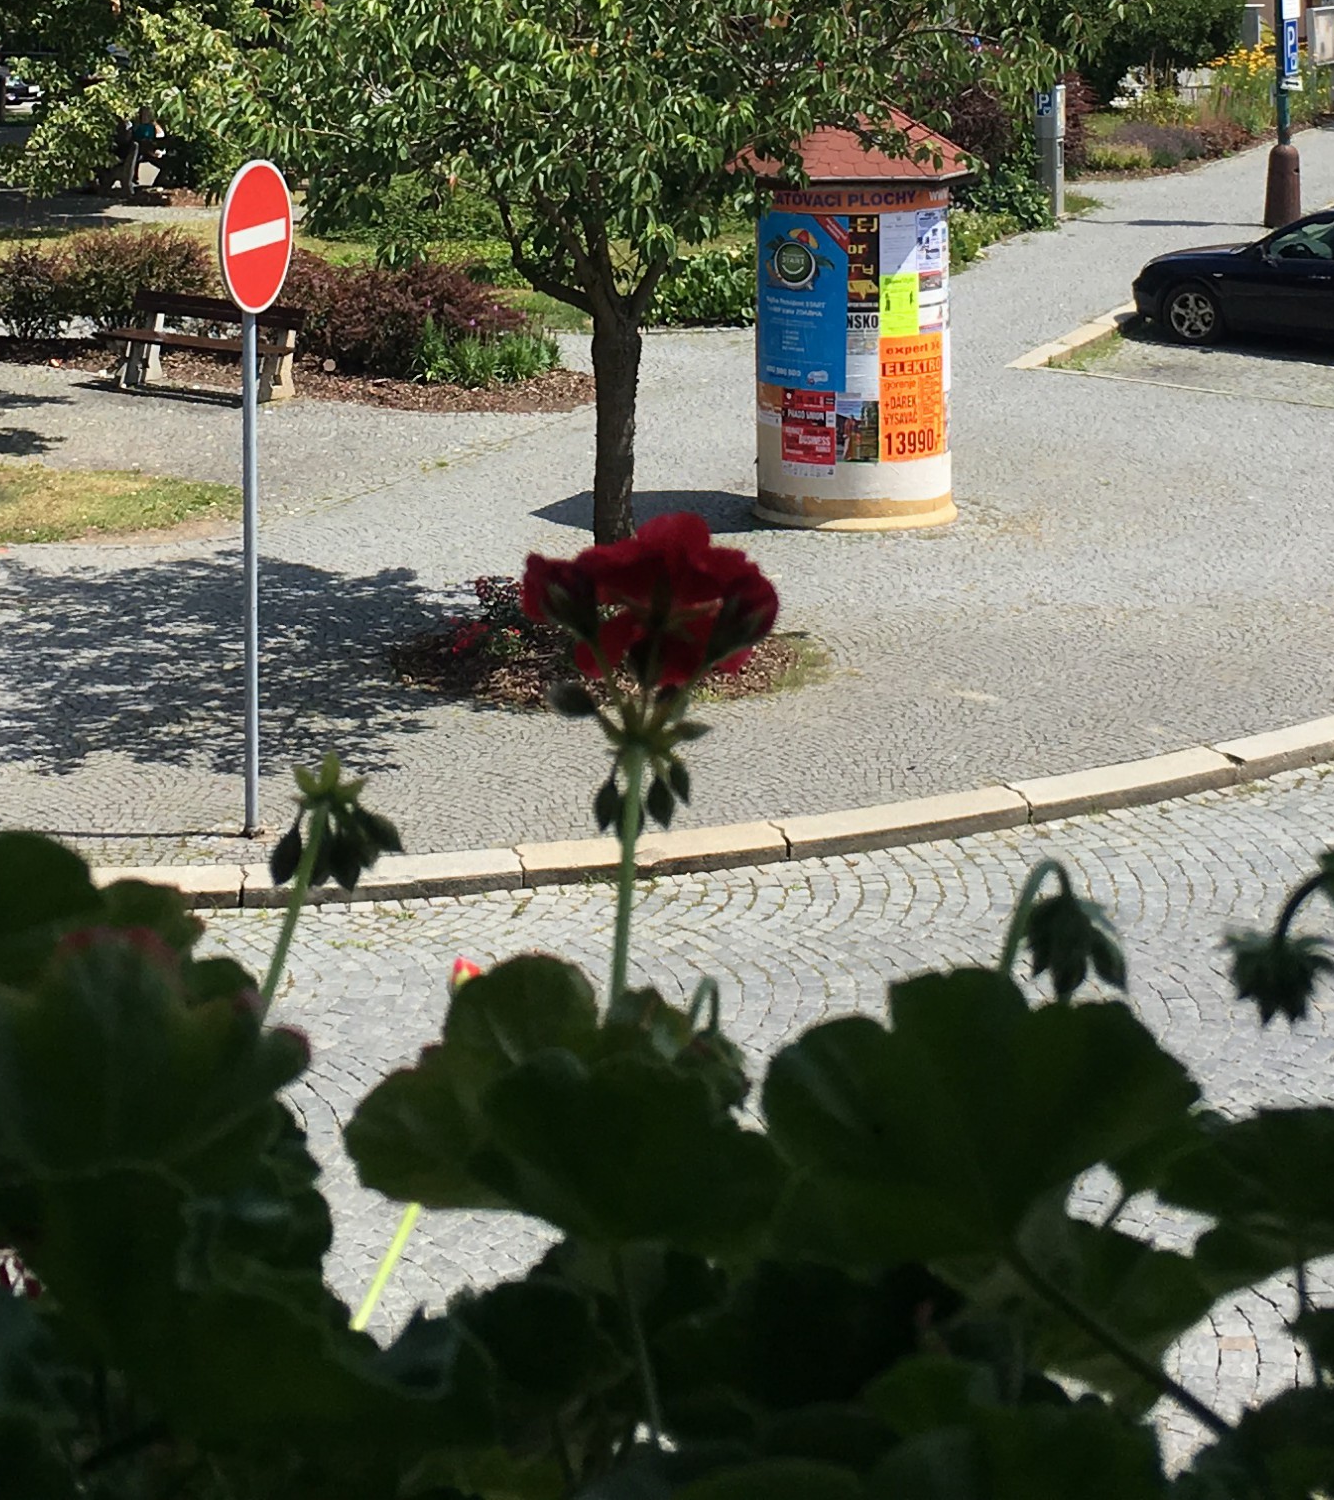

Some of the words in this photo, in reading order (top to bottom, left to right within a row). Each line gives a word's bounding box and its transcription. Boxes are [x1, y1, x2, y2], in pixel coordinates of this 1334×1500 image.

[1287, 26, 1295, 58] P
[776, 192, 842, 207] ATOVACI
[848, 190, 916, 206] PLOCHY
[886, 343, 928, 355] expert
[887, 357, 941, 376] ELEKTRO
[884, 380, 916, 391] gorenje
